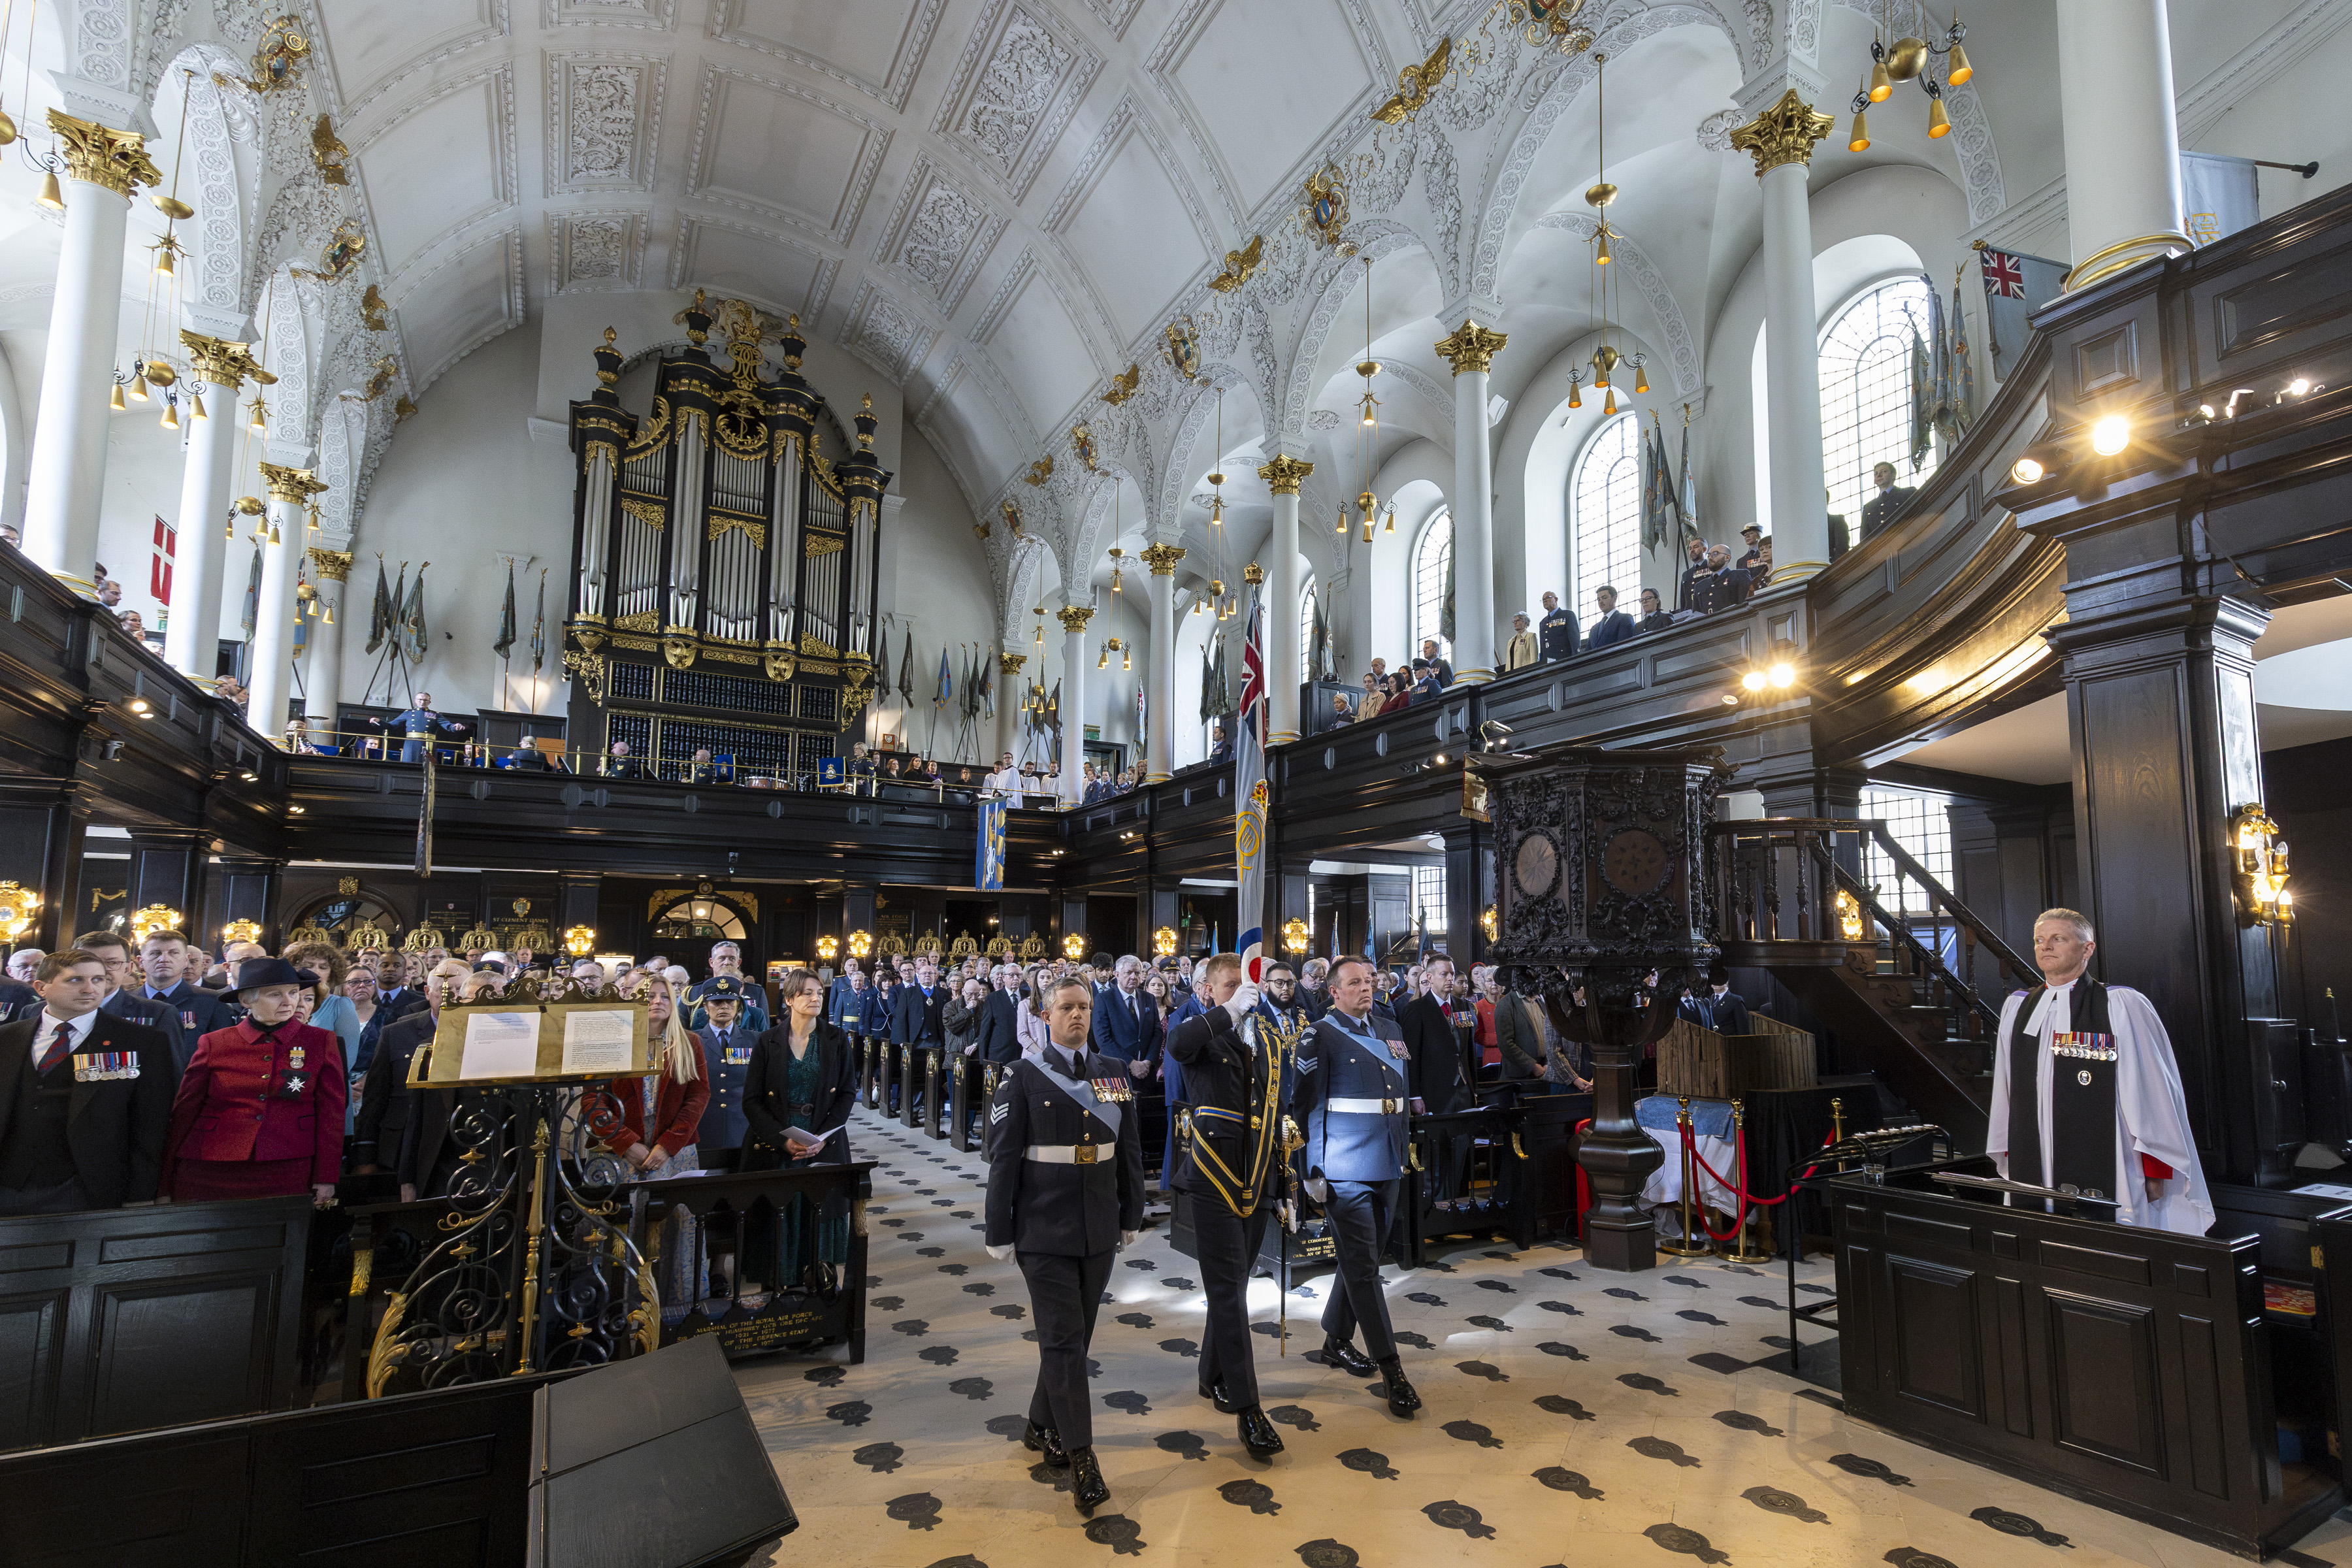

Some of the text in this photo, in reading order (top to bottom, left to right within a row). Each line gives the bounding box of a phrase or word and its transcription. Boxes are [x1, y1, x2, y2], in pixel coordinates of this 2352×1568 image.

[696, 1324, 727, 1333] MARSHAL
[725, 1326, 760, 1334] HUMPHREY
[757, 1331, 787, 1341] DEFENCE
